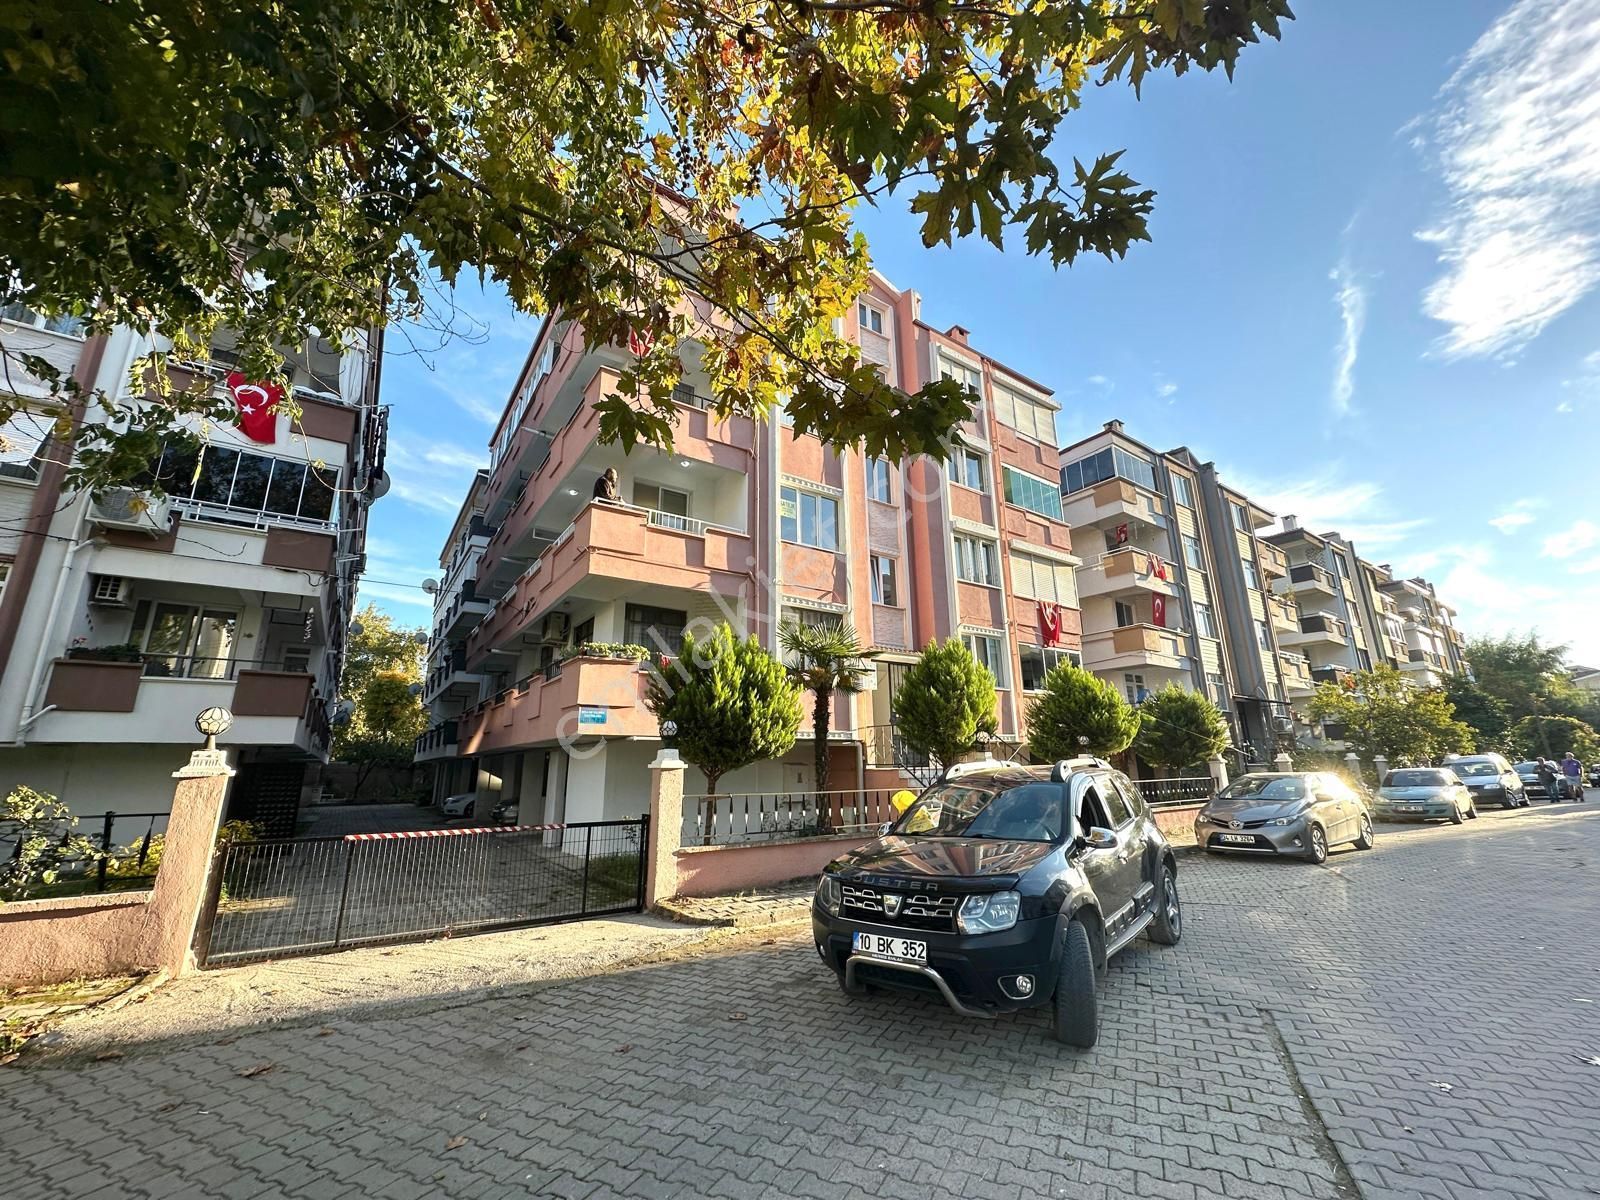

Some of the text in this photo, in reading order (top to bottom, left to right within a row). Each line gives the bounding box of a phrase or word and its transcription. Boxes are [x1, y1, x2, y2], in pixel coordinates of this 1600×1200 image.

[860, 934, 871, 950] 10
[877, 937, 895, 954] BK
[901, 941, 926, 960] 352
